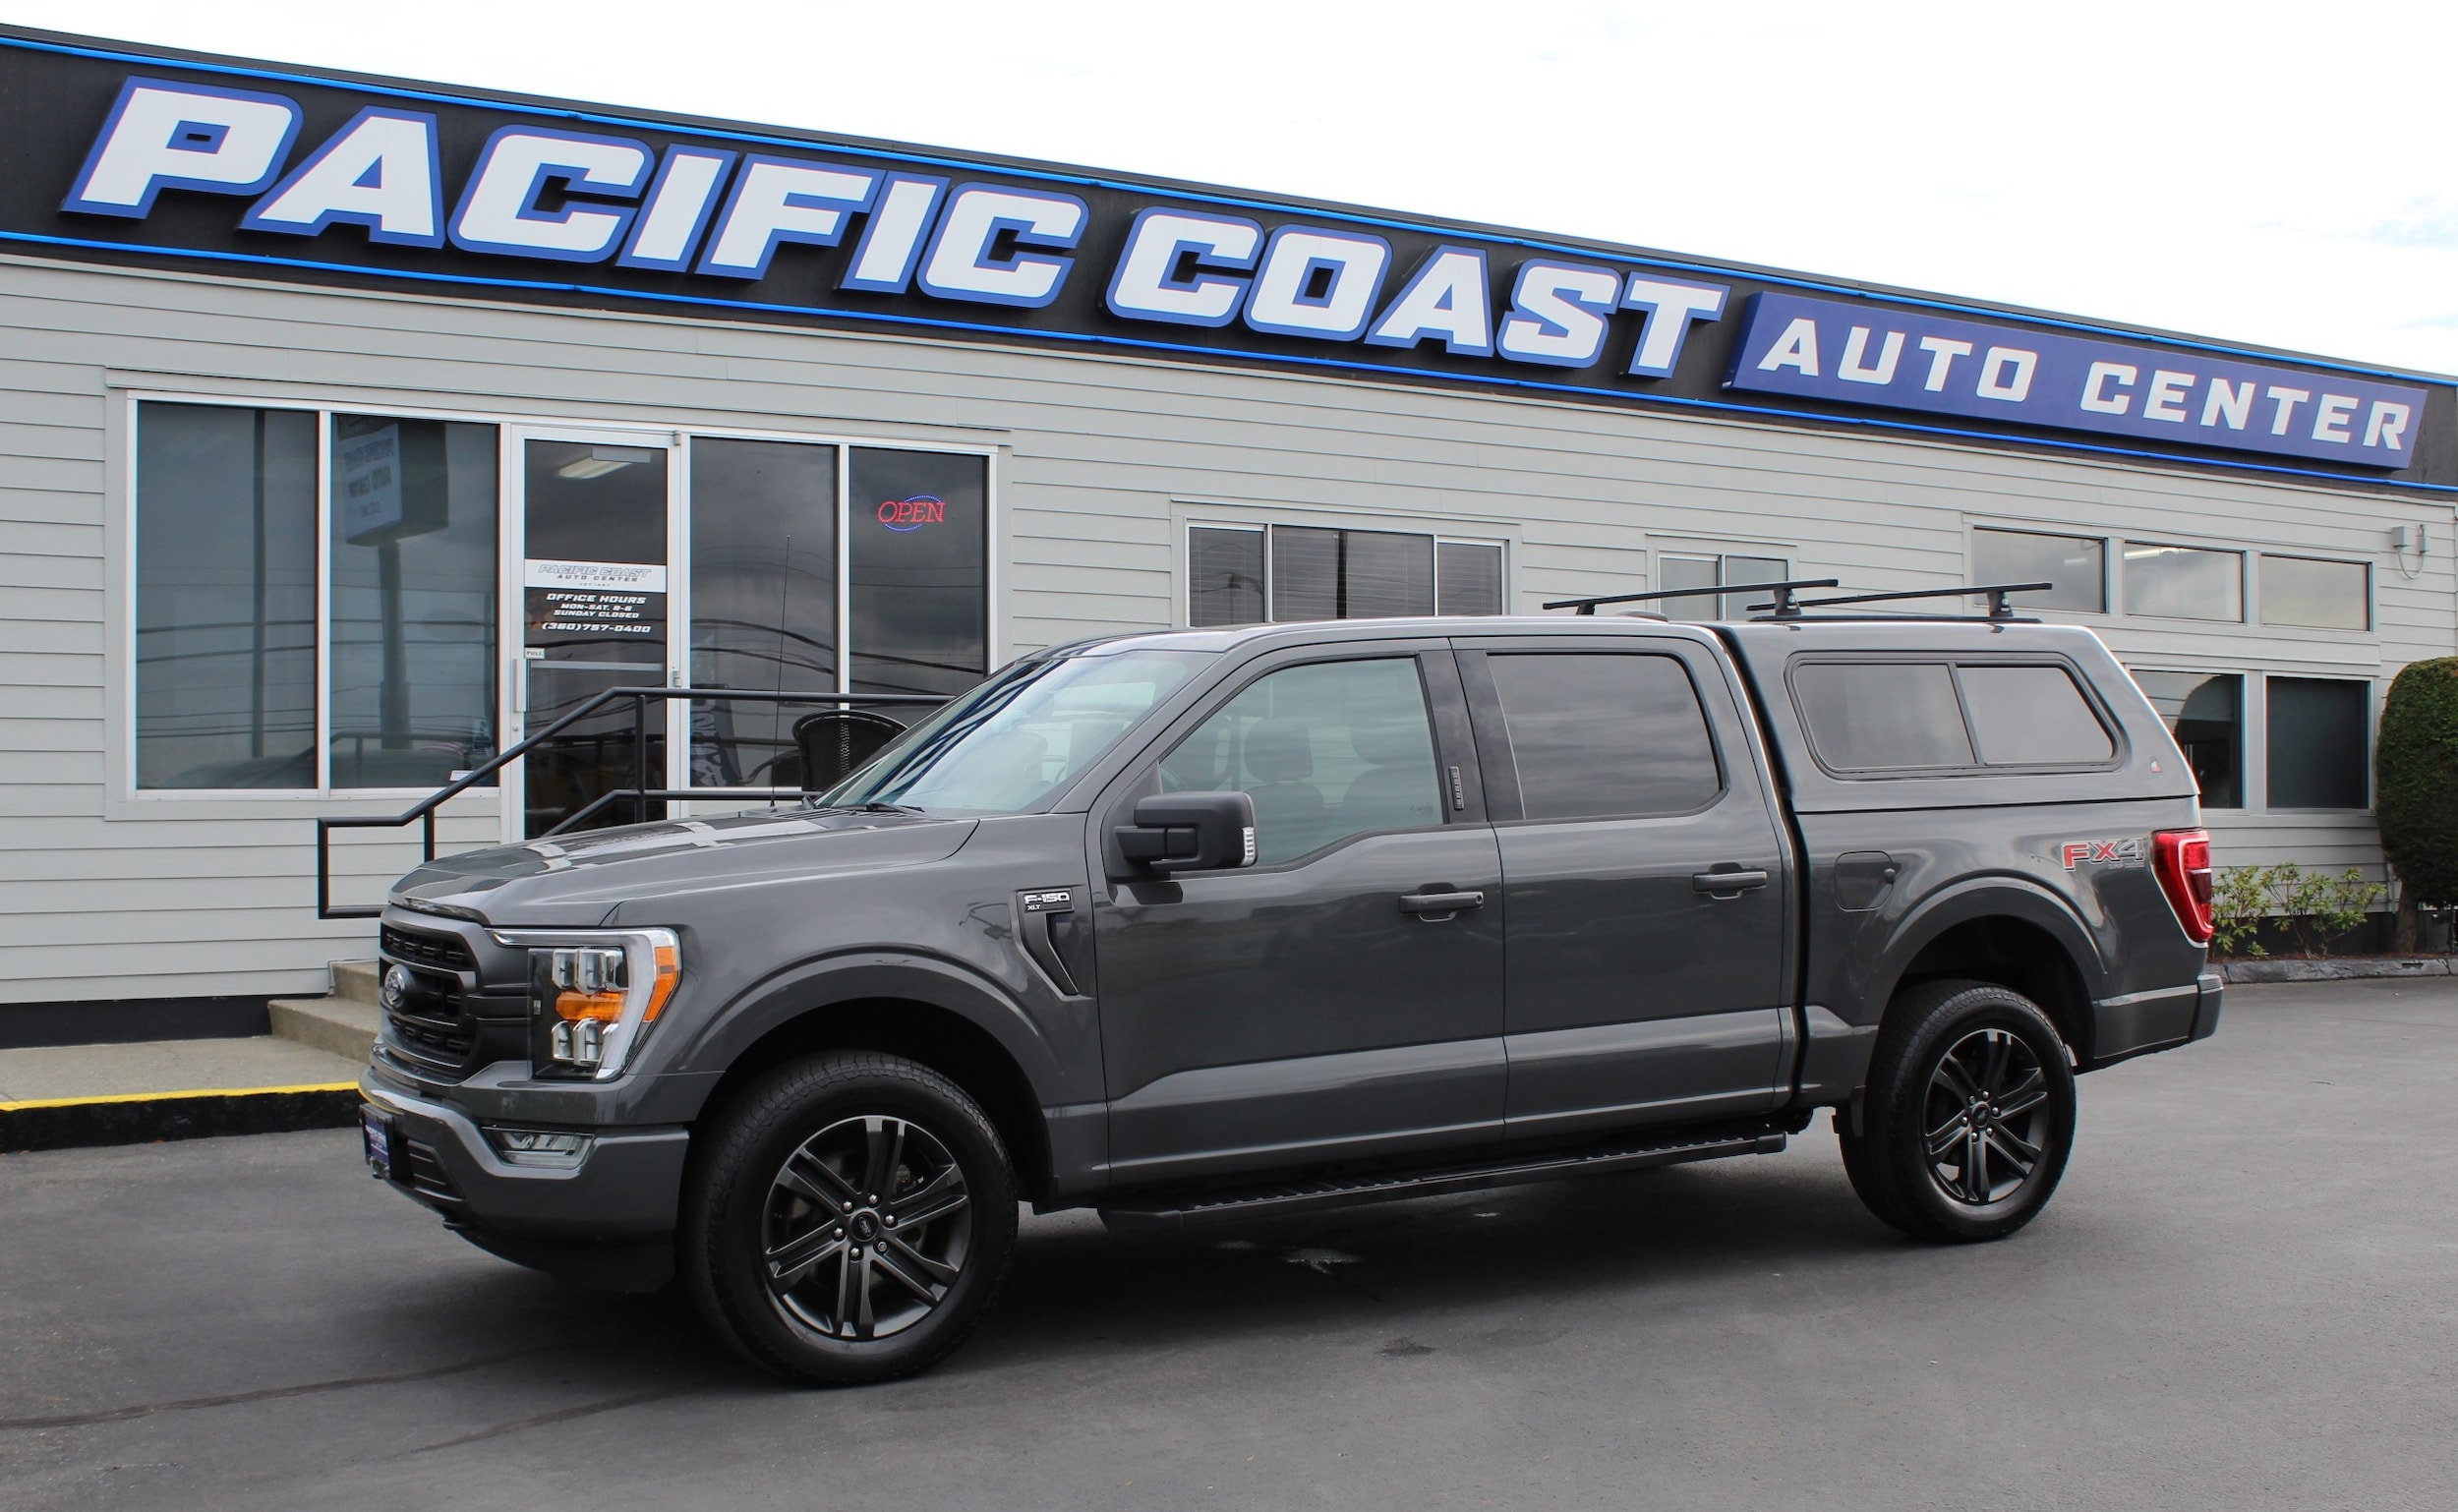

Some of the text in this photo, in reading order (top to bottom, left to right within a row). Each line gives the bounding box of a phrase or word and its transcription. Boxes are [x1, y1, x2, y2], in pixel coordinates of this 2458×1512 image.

[60, 75, 1731, 378] PACIFIC COAST
[1757, 318, 2410, 450] AUTO CENTER
[878, 500, 945, 523] OPEN
[538, 564, 652, 577] PACIFIC COAST
[547, 593, 647, 604] OFFICE HOURS
[2061, 838, 2145, 872] FX4
[1024, 892, 1070, 904] F-150
